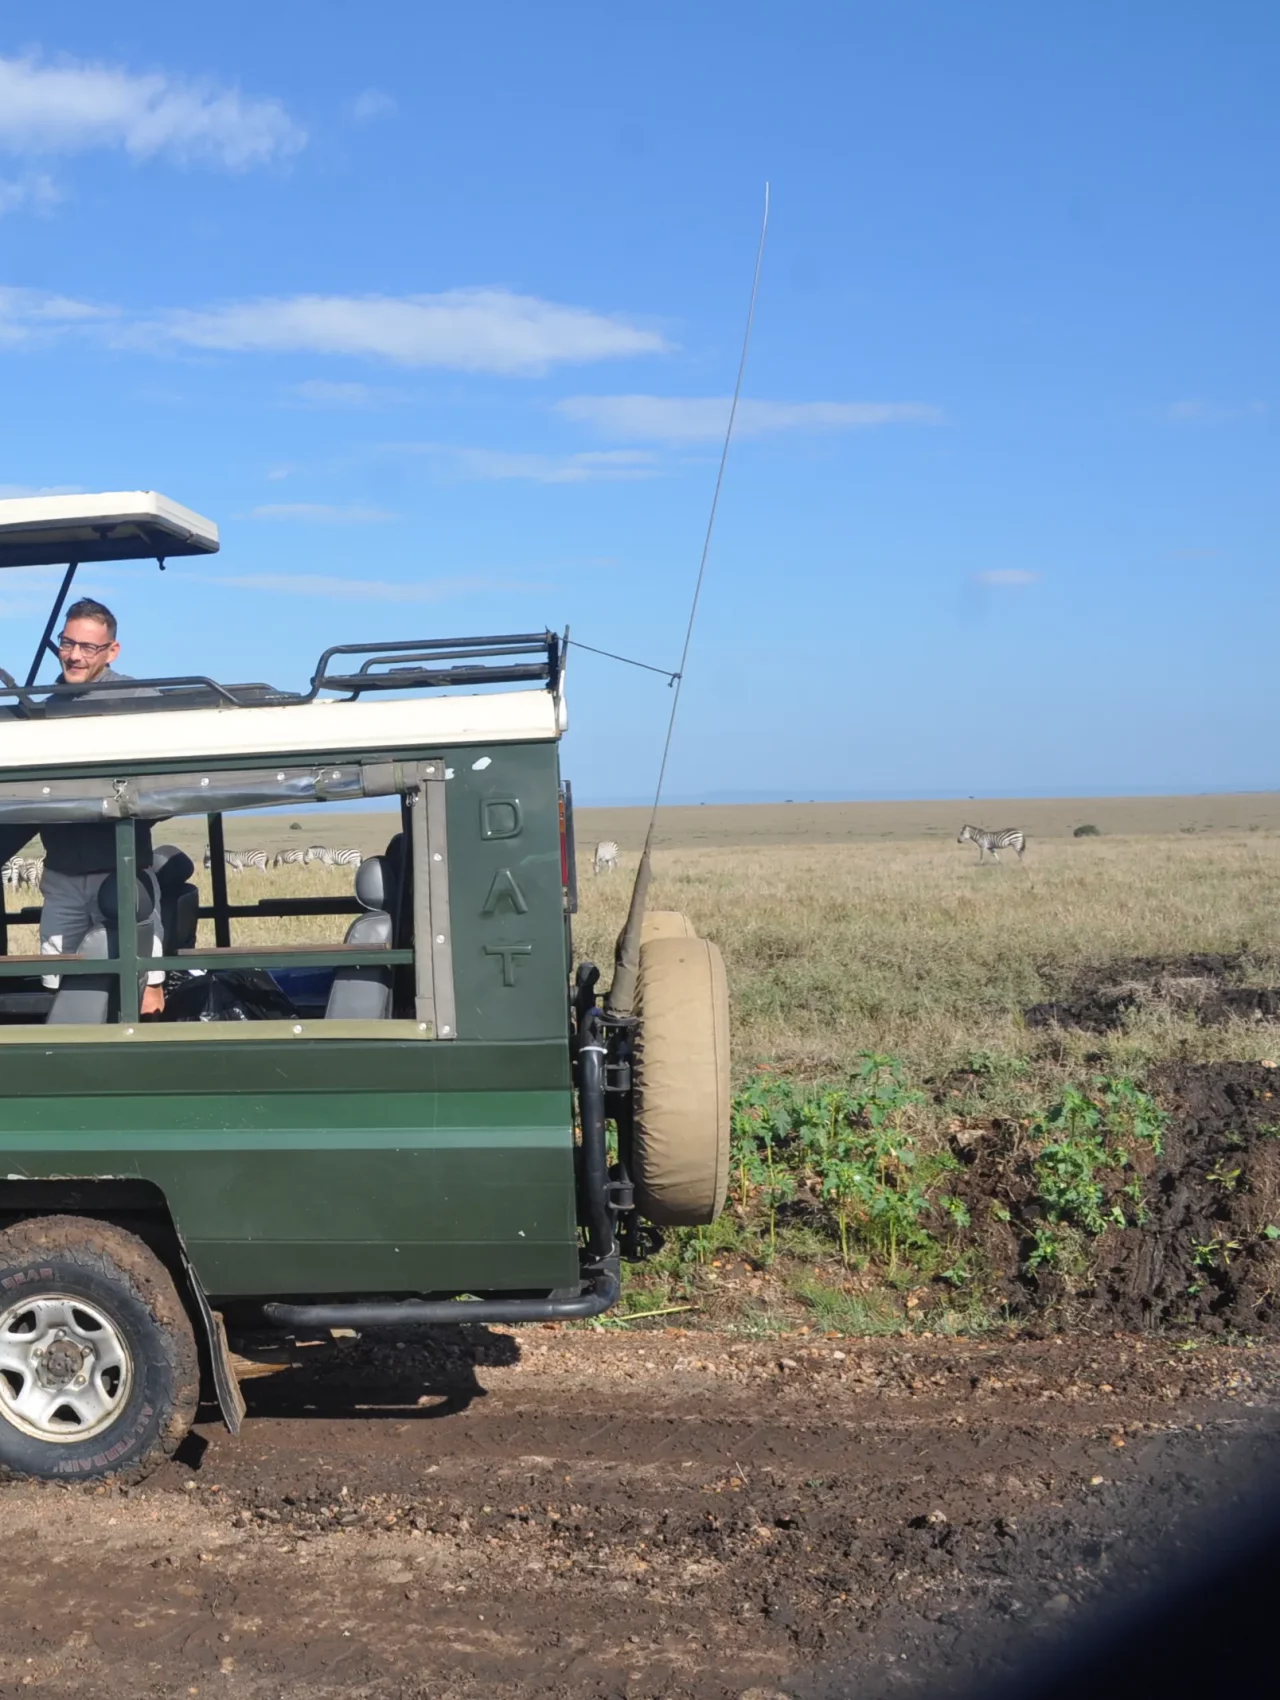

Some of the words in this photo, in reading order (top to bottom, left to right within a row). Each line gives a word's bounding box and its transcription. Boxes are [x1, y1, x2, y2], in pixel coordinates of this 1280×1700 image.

[479, 798, 532, 988] DAT
[1, 1267, 54, 1289] BEAR
[131, 1402, 154, 1434] ALL
[58, 1436, 136, 1473] TERRAIN
